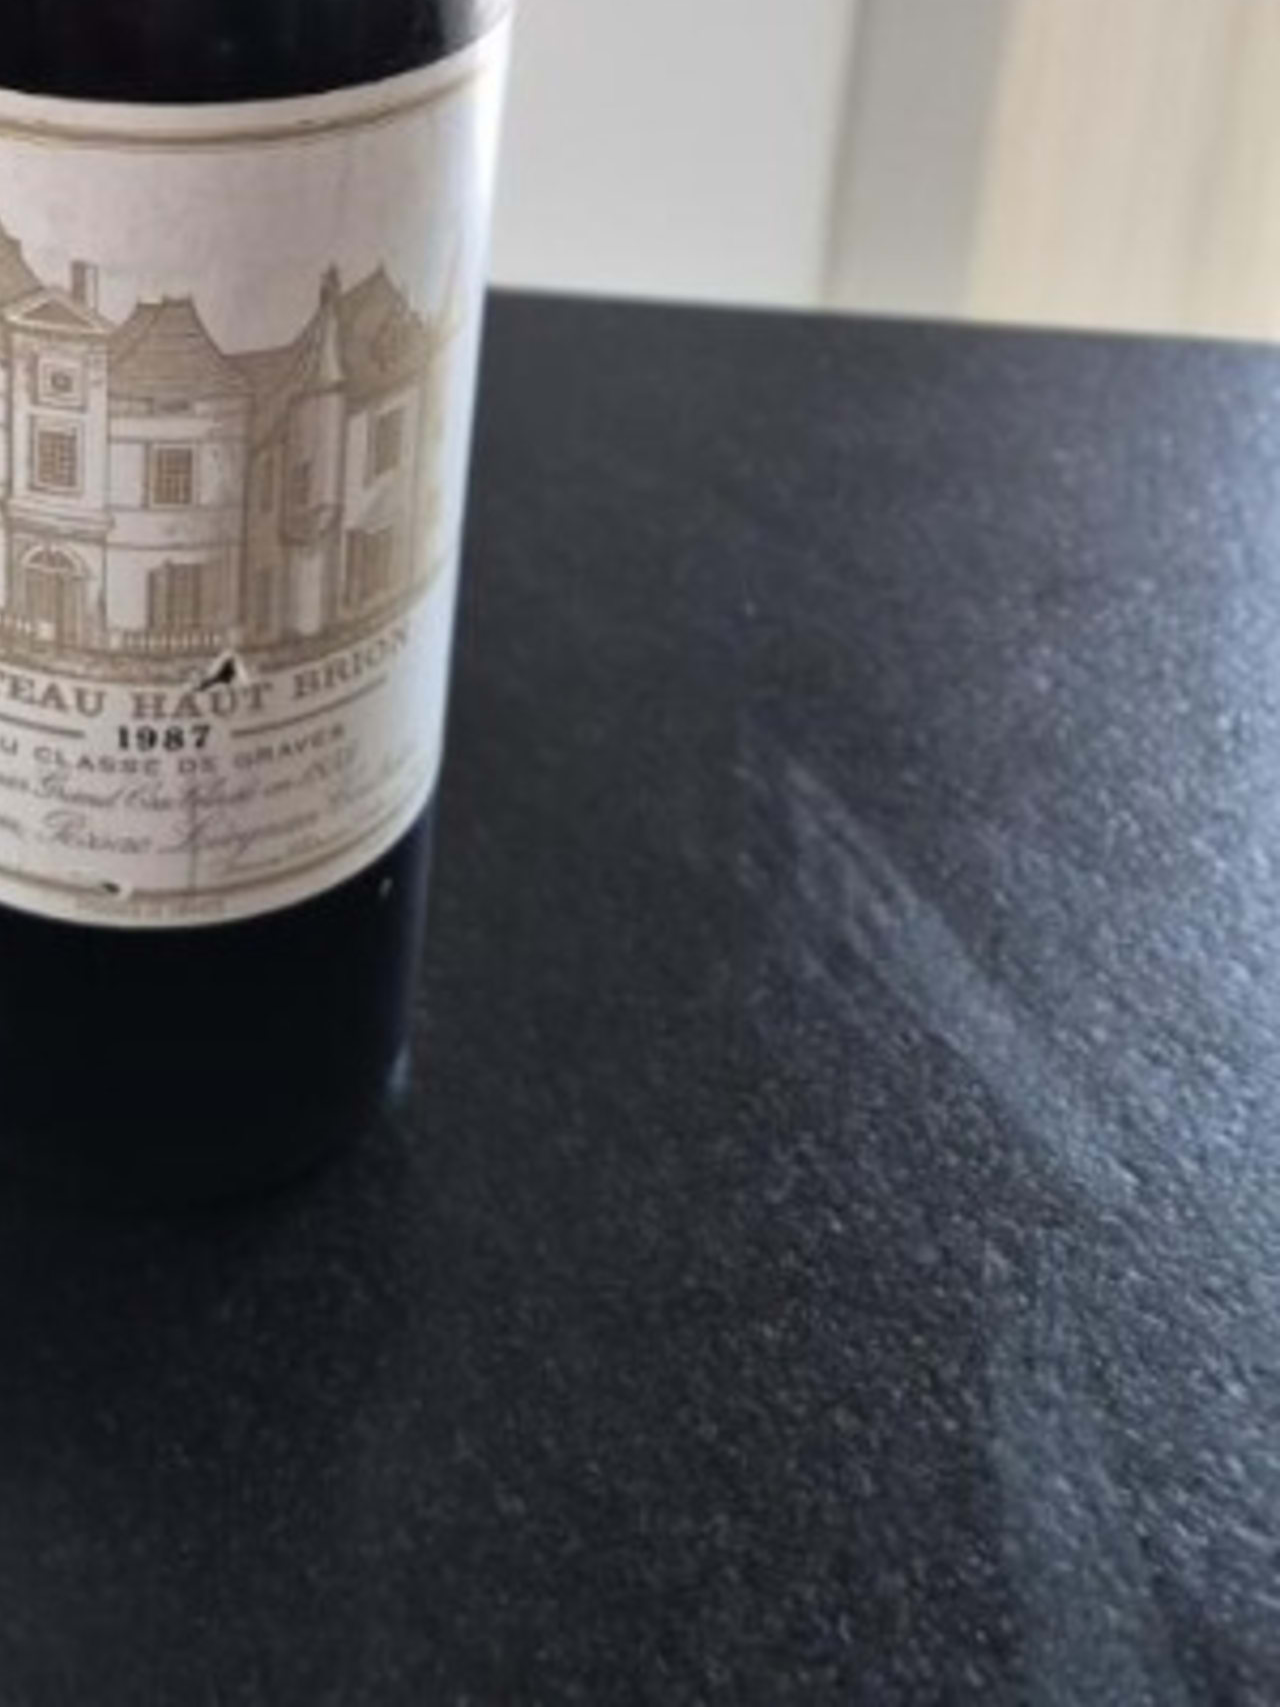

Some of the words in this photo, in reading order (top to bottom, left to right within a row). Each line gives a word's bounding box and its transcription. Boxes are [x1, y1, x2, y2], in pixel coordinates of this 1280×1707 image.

[131, 680, 272, 719] HAUT
[291, 627, 408, 699] BRION
[117, 723, 212, 752] 1987
